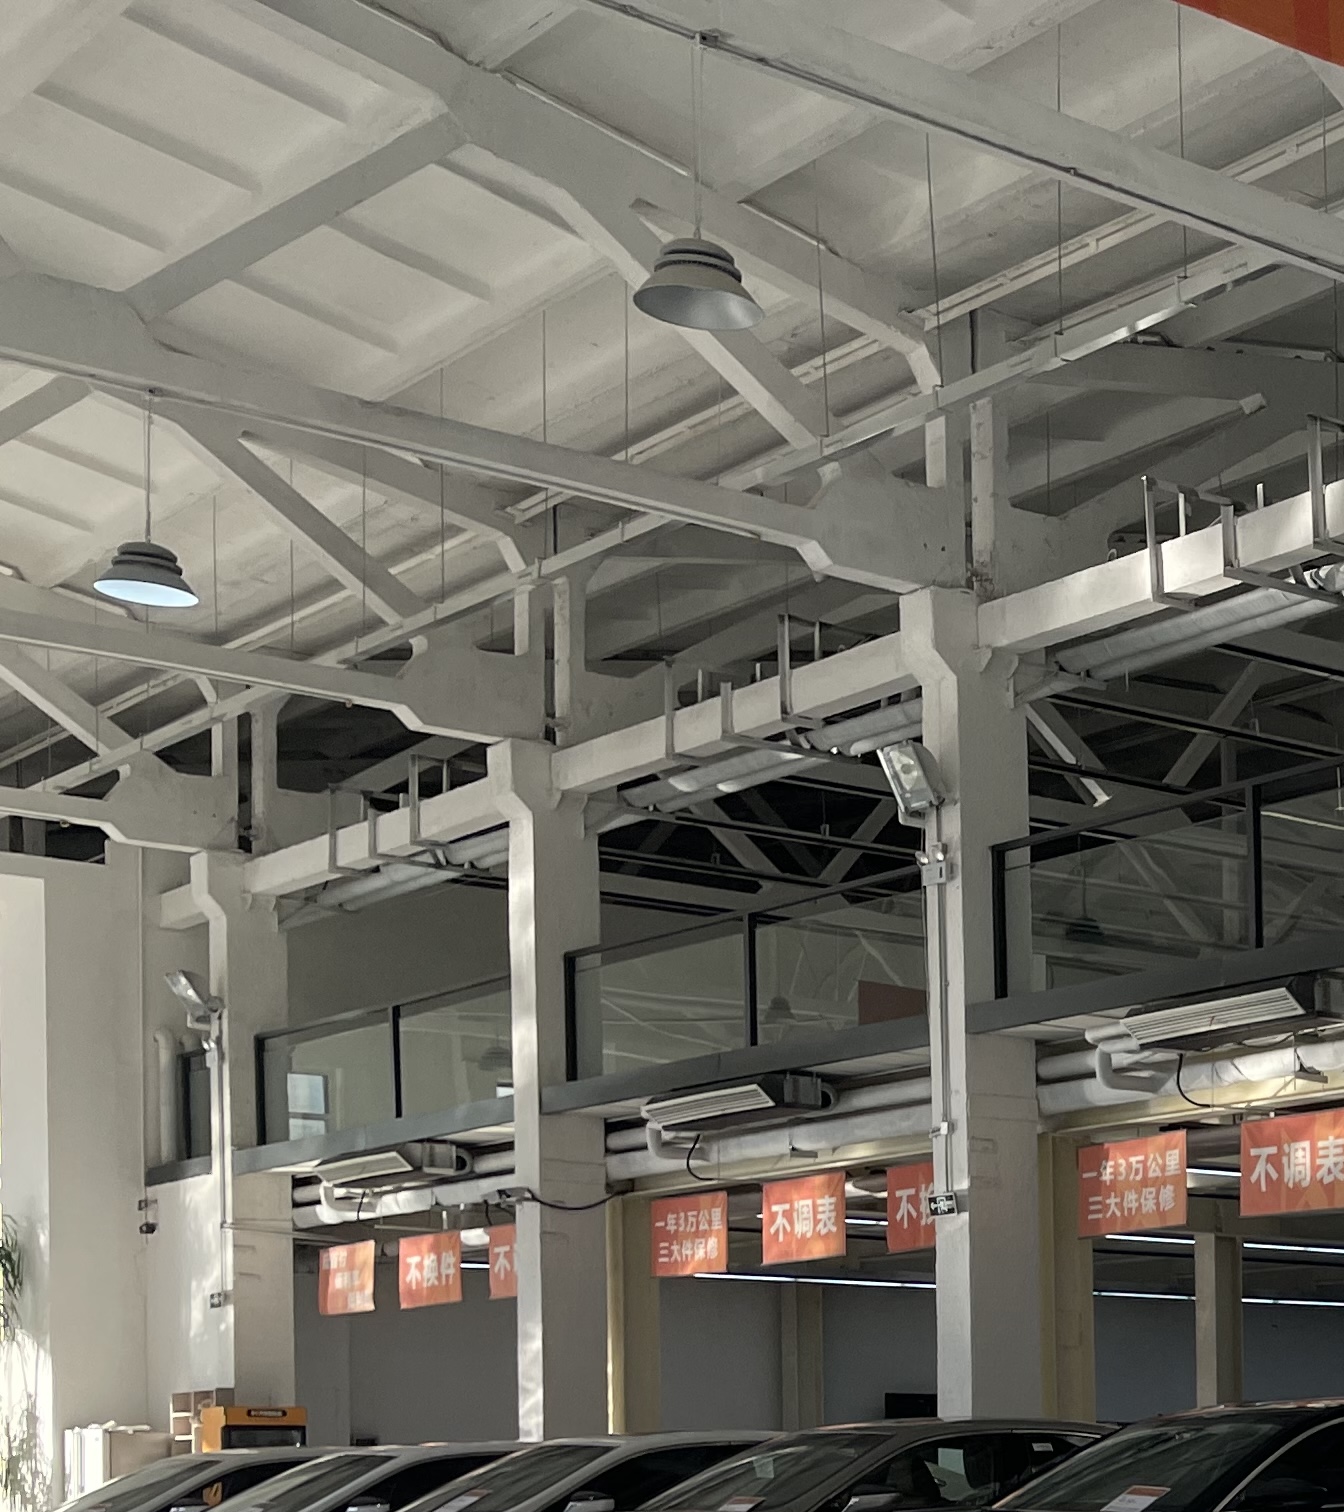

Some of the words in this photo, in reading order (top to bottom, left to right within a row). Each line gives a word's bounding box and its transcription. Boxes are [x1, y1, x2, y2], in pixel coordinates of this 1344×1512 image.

[1082, 1150, 1181, 1187] 一年3万公里
[655, 1207, 722, 1235] 一年3万公里
[770, 1195, 837, 1242] 不调表
[1087, 1185, 1176, 1220] 三大件保修
[405, 1250, 456, 1290] 不换件
